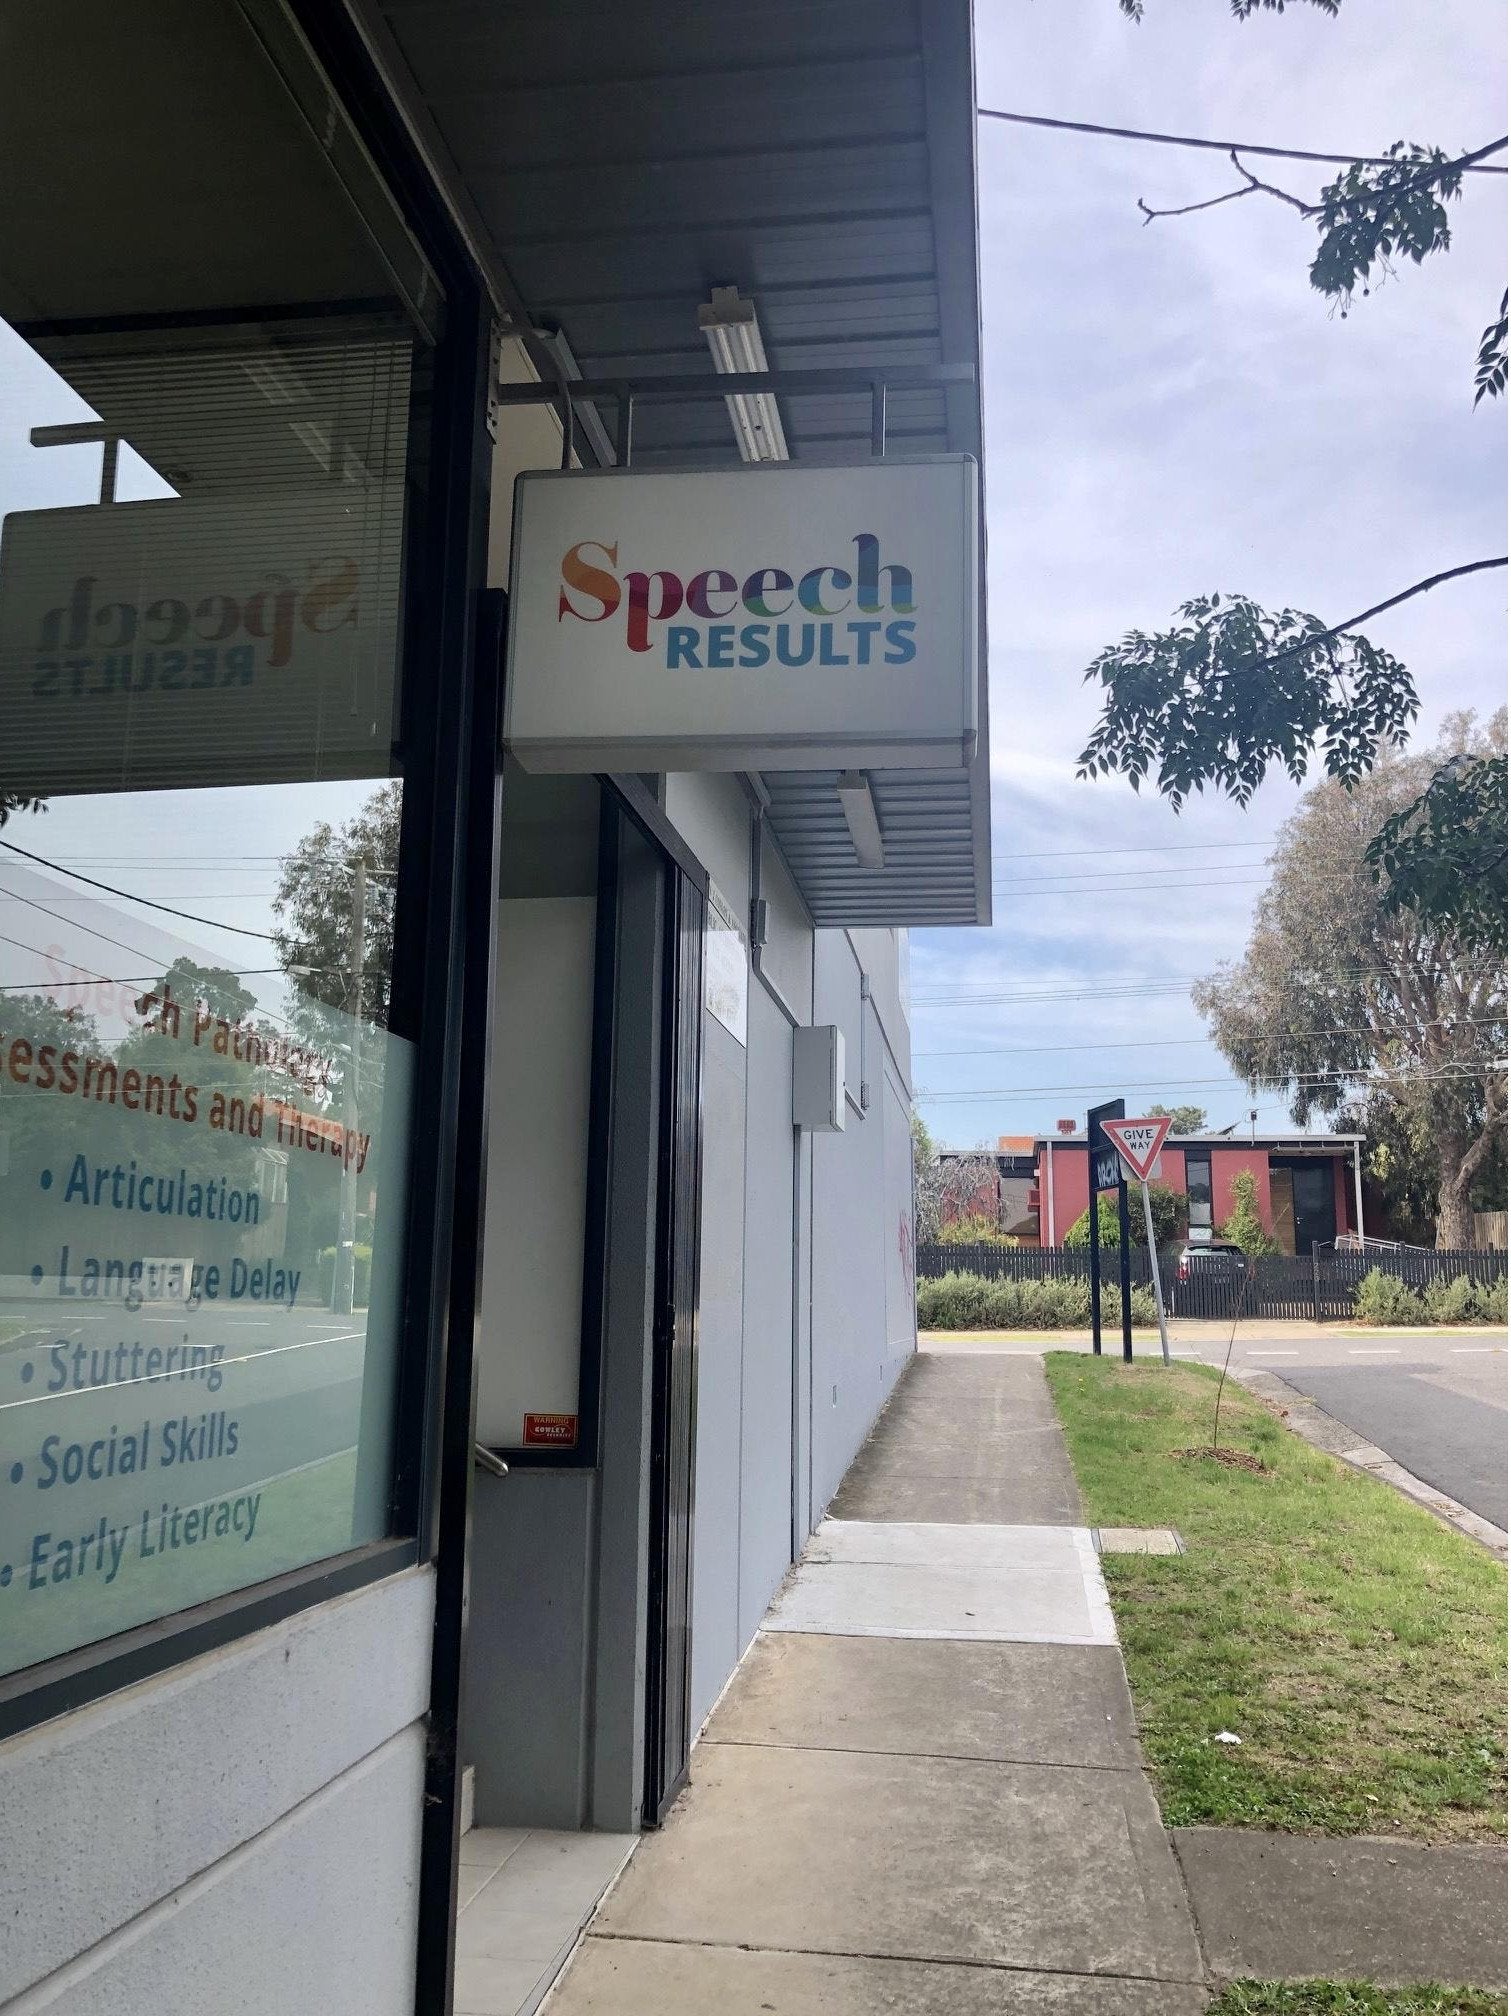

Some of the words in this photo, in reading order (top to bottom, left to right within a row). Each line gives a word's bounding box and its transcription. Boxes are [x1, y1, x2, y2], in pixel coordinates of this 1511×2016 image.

[558, 533, 918, 652] Speech
[666, 620, 917, 669] RESULTS
[209, 1092, 264, 1139] and
[274, 1099, 371, 1174] Therapy
[1123, 1128, 1155, 1140] GIVE
[1130, 1141, 1151, 1150] WAY
[64, 1153, 261, 1225] Articulation
[58, 1245, 220, 1312] Language
[229, 1257, 302, 1312] Delay
[47, 1333, 226, 1393] Stuttering
[37, 1420, 150, 1490] Social
[160, 1410, 239, 1468] Skills
[533, 1416, 569, 1424] WARNING
[28, 1517, 129, 1591] Early
[139, 1492, 262, 1560] Literacy
